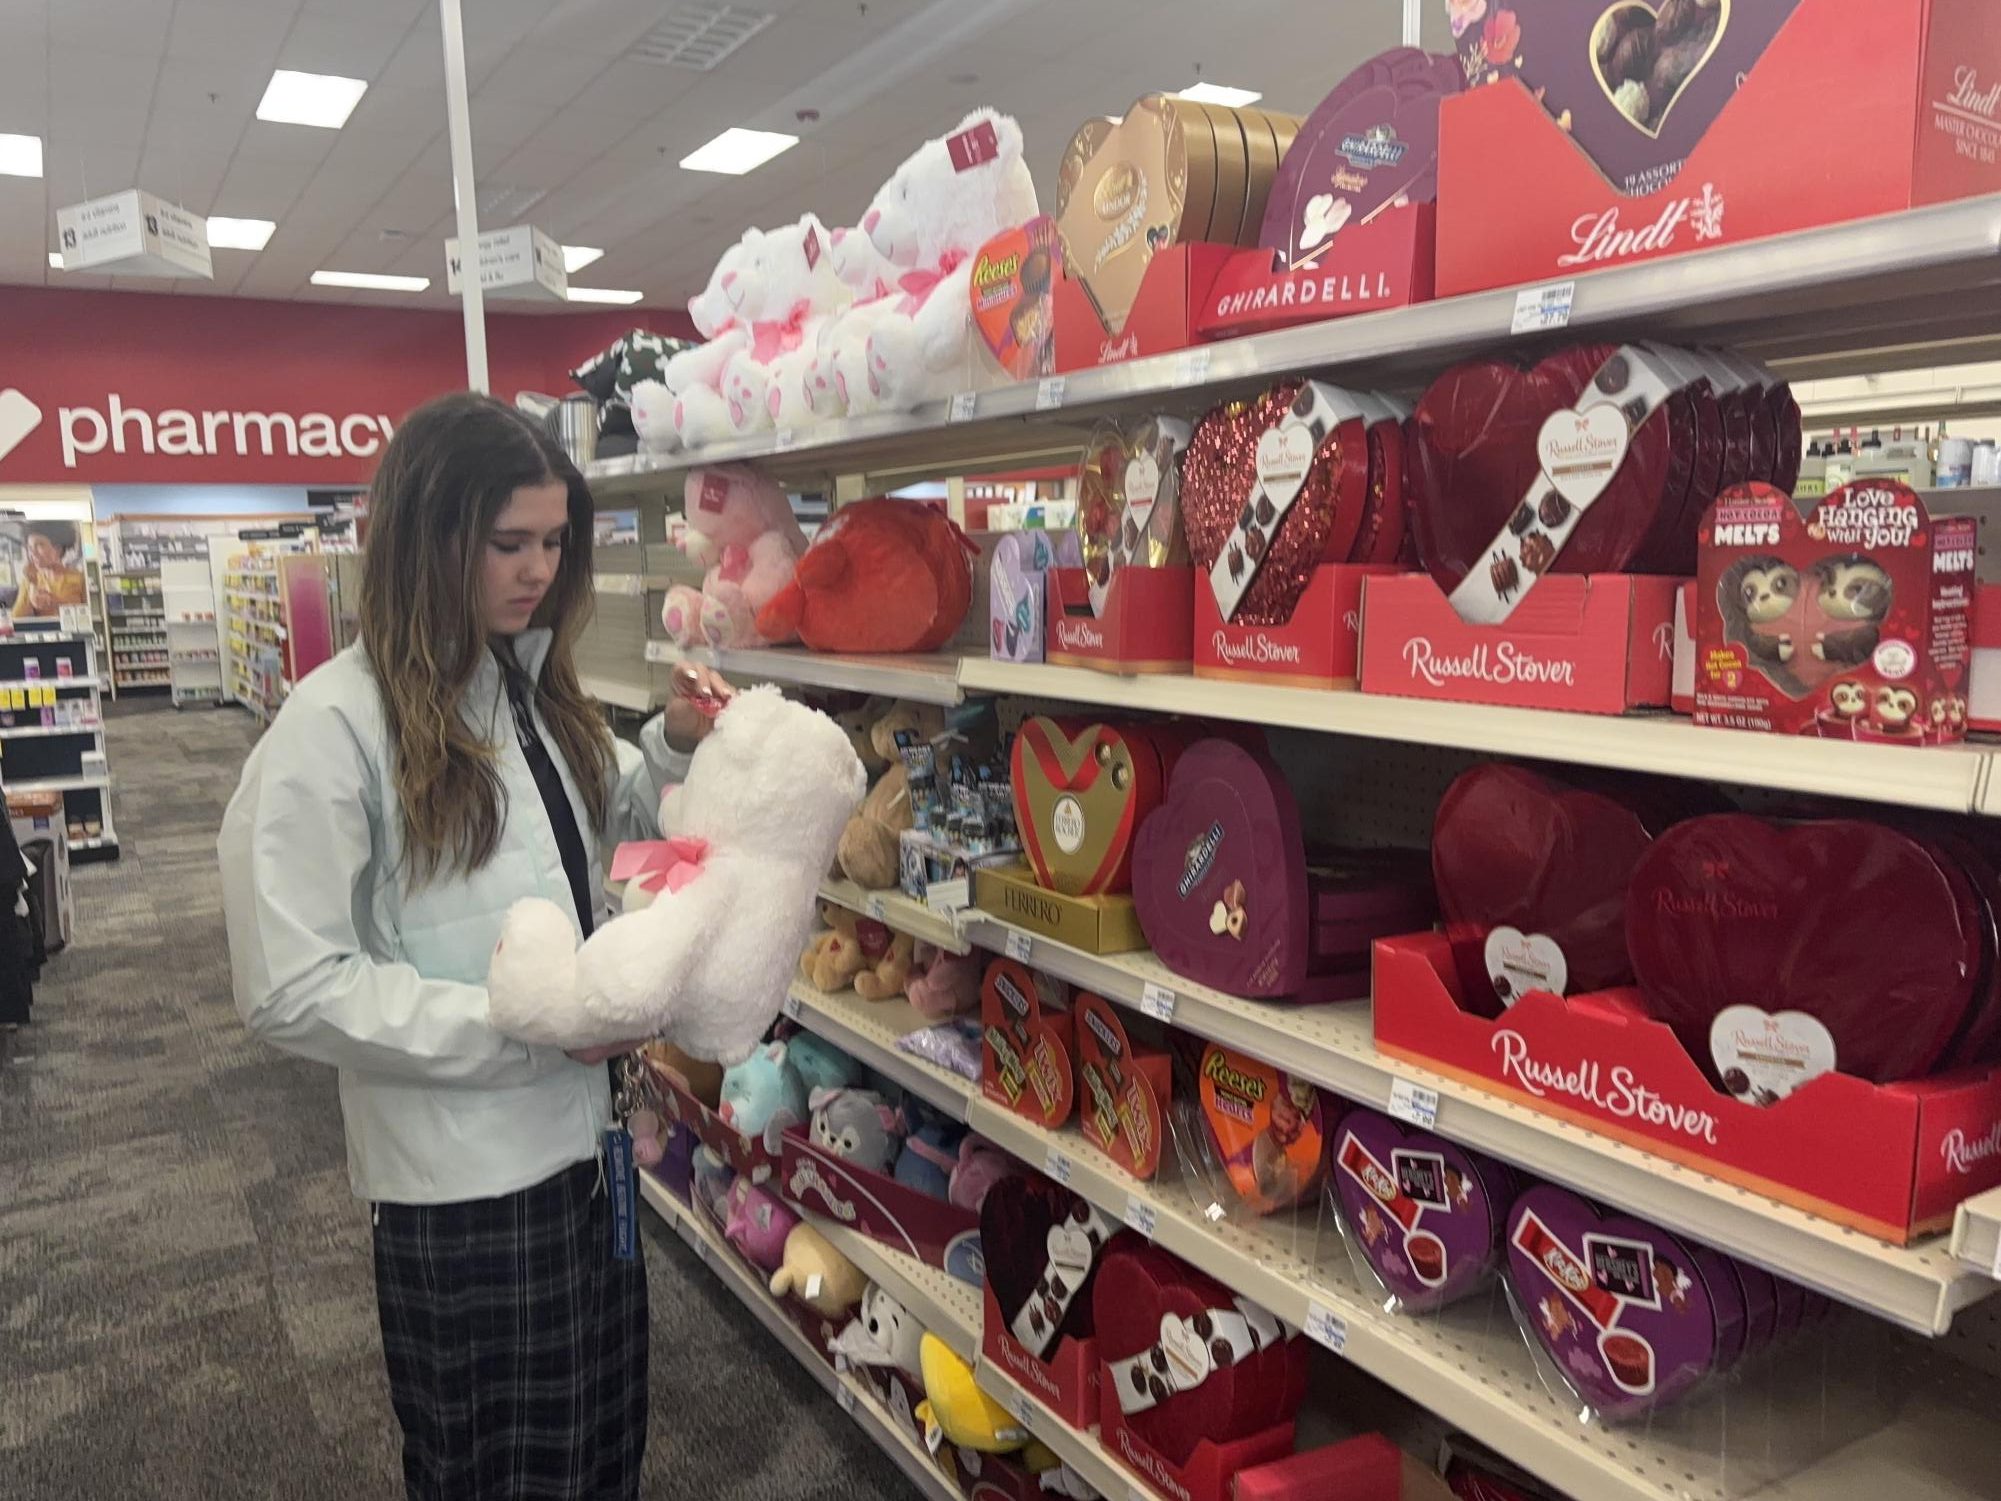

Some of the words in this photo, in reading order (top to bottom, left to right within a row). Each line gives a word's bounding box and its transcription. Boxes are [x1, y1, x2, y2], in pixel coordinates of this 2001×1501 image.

[63, 226, 77, 249] 13
[1556, 197, 1690, 267] Lindt
[1217, 271, 1385, 317] GHIRARDELLI
[1714, 522, 1780, 547] MELTS
[1932, 548, 1975, 574] MELTS
[1056, 618, 1081, 649] Russell
[1080, 621, 1103, 649] Stover
[1212, 629, 1256, 666] Russell
[1256, 632, 1299, 665] Stover
[1402, 636, 1493, 687] Russell
[1492, 641, 1574, 687] Stover
[1179, 825, 1221, 896] GHIRARDELLI
[1004, 885, 1061, 927] FERRERO
[1205, 1049, 1267, 1102] Reese's
[1491, 1028, 1607, 1109] Russell
[1606, 1066, 1717, 1144] Stover
[997, 1334, 1030, 1375] Russell
[1029, 1360, 1061, 1401] Stover
[1116, 1427, 1155, 1479] Russell
[1154, 1459, 1191, 1501] Stover
